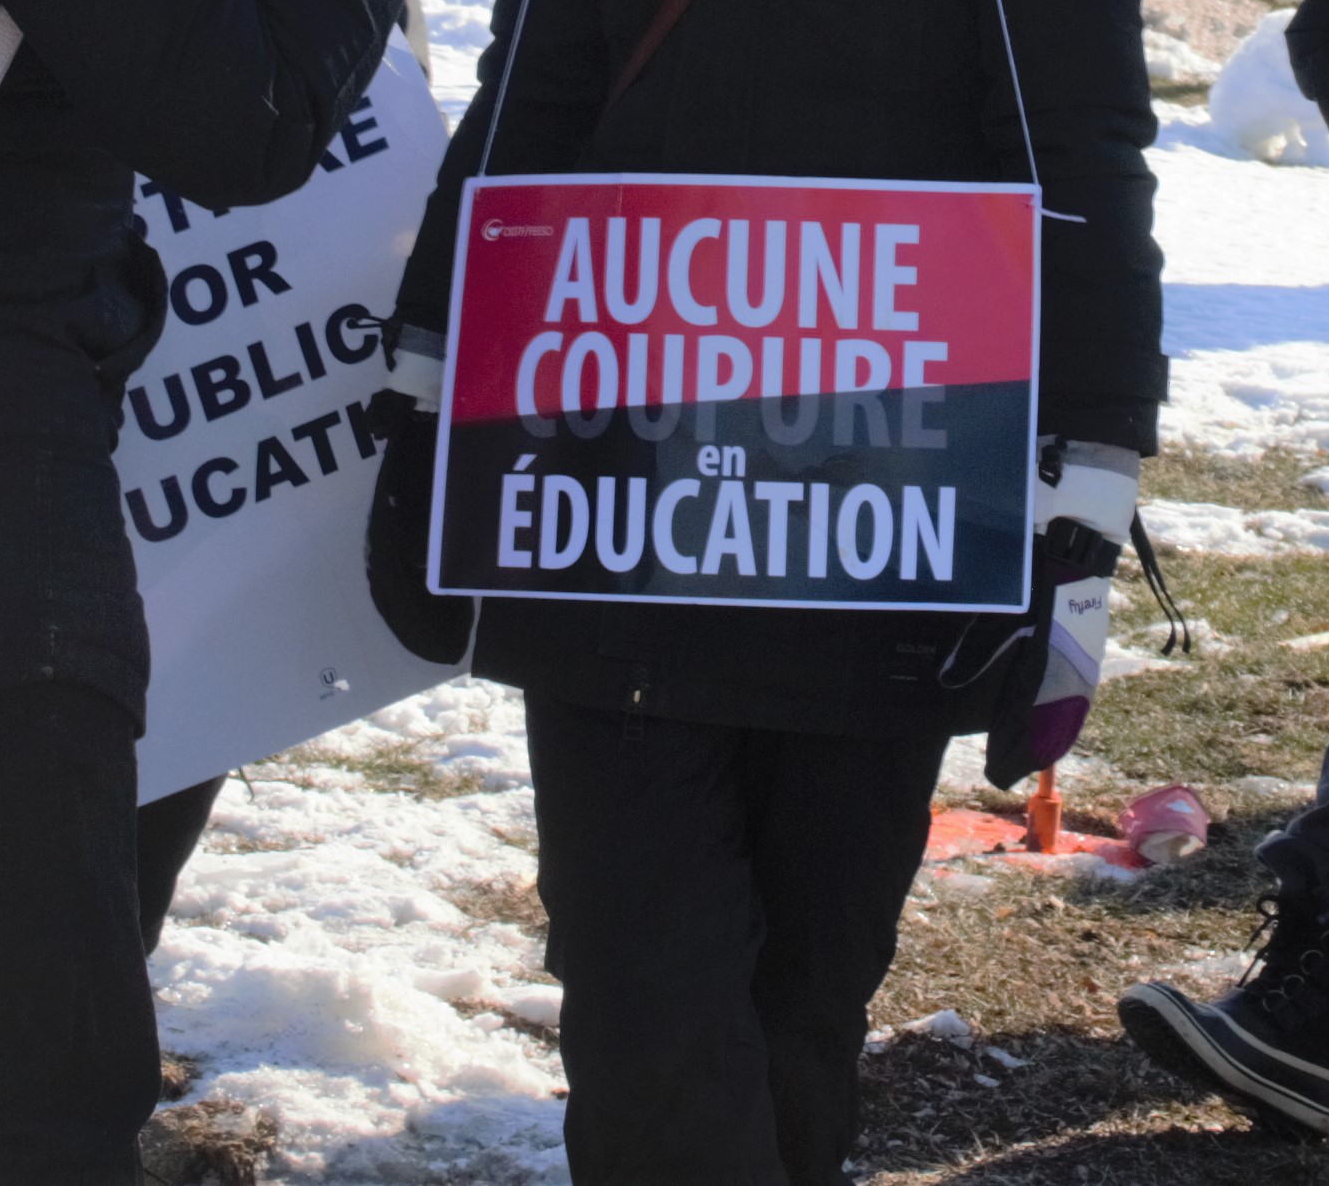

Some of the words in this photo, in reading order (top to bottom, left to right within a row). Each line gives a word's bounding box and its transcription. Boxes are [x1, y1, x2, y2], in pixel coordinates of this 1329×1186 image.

[170, 240, 293, 326] OR
[544, 216, 920, 332] AUCUNE
[127, 303, 380, 441] UBLIC
[515, 330, 949, 450] COUPURE
[124, 400, 378, 543] UCATI
[496, 454, 956, 582] ÉDUCATION
[697, 443, 746, 478] en
